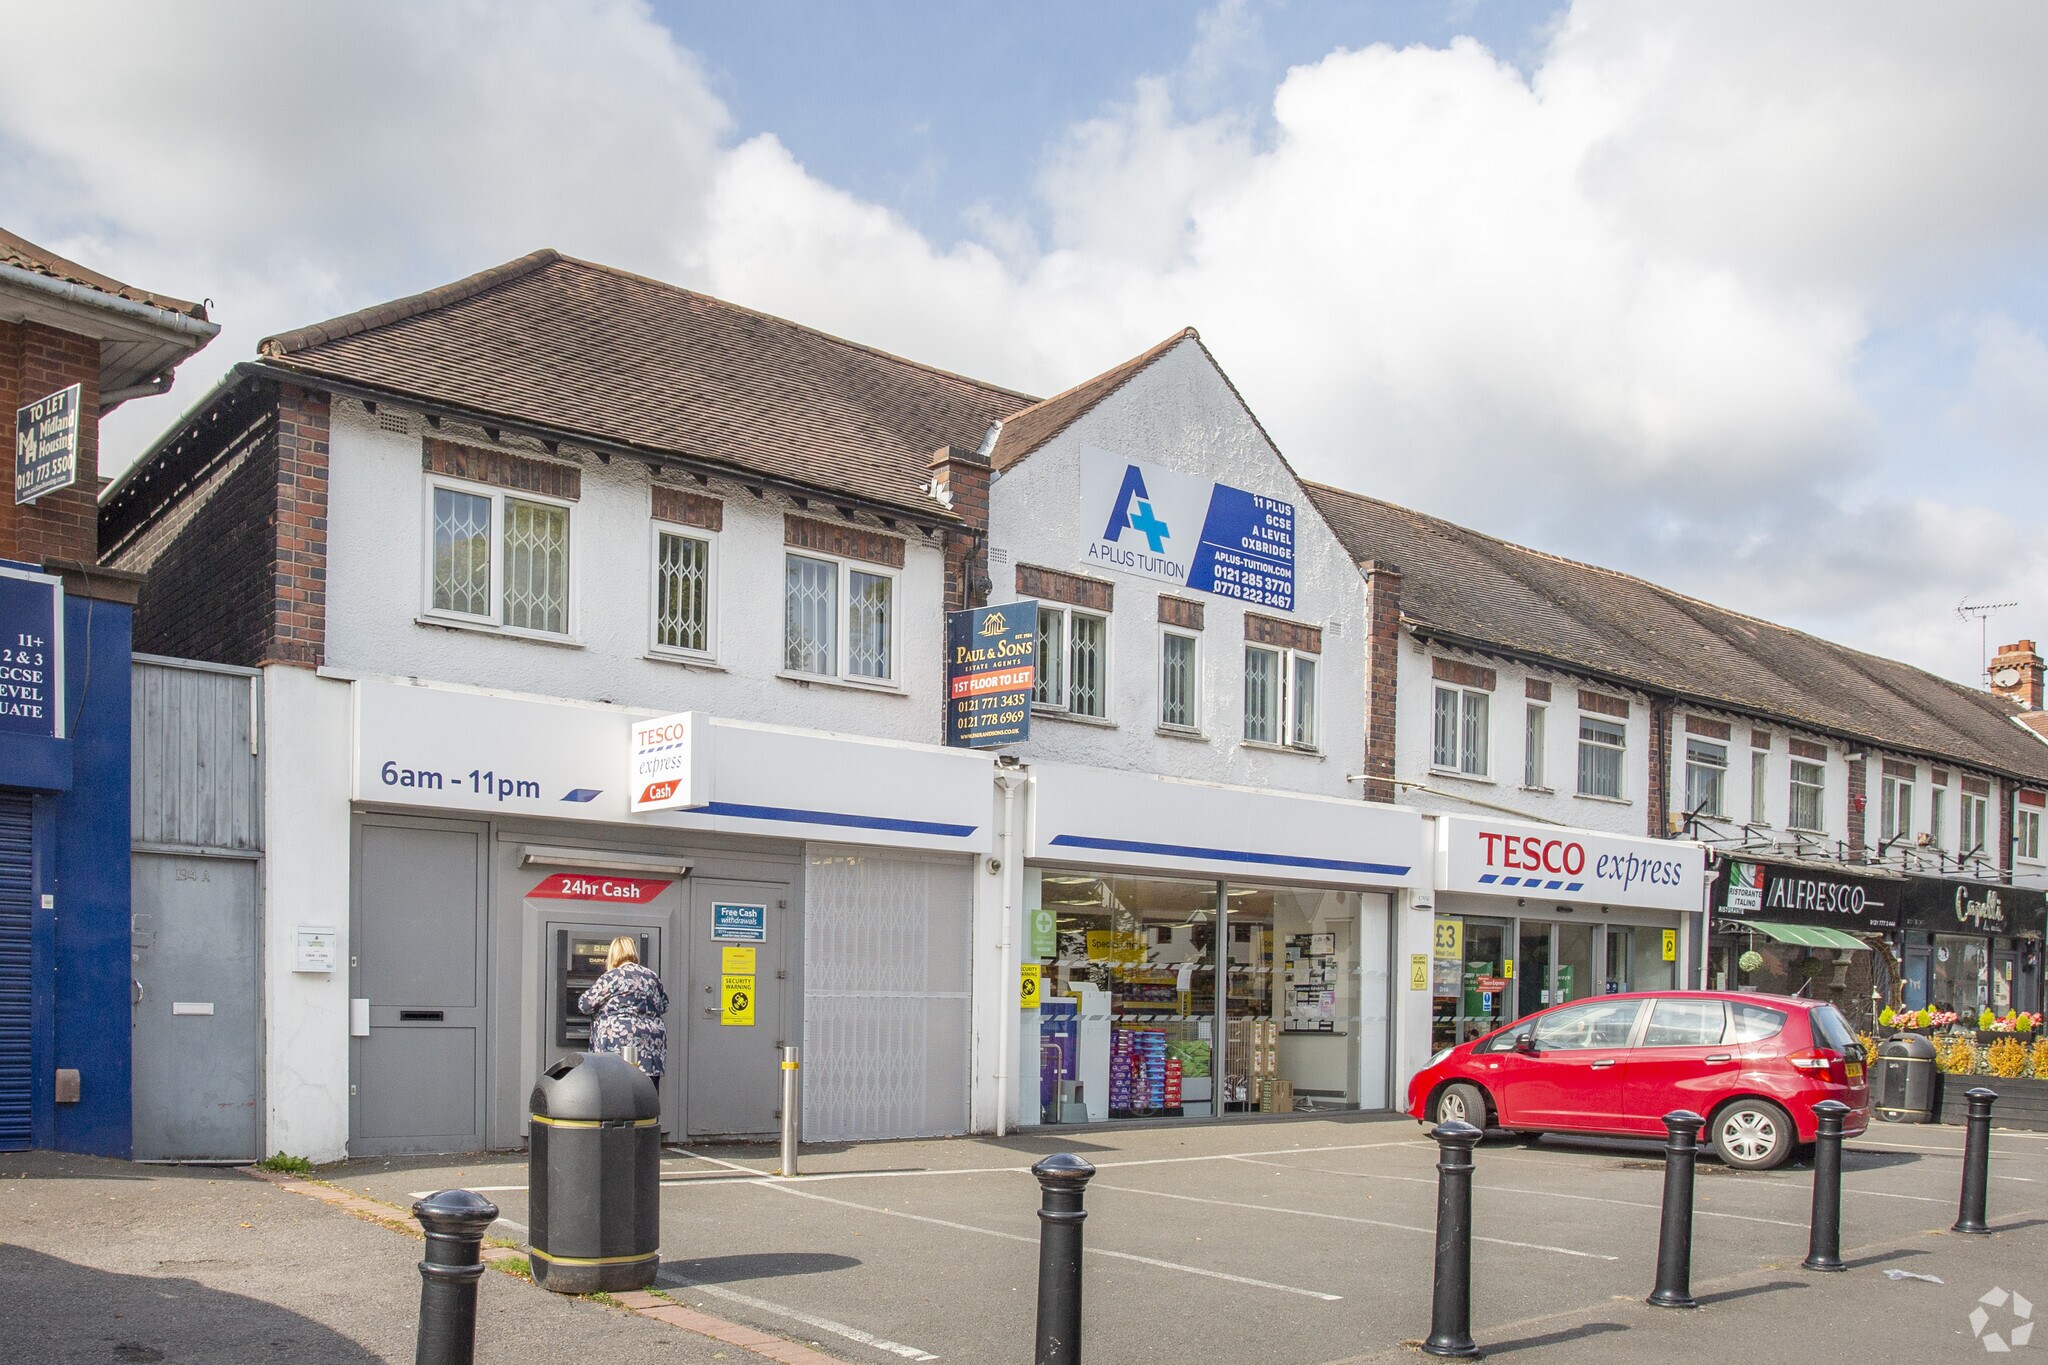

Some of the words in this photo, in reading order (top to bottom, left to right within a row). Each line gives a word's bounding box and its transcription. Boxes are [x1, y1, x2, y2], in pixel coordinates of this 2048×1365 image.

[30, 404, 43, 423] TO
[46, 393, 65, 416] LET
[40, 409, 74, 439] Midland
[39, 433, 74, 458] Housing
[17, 471, 34, 490] 0121
[37, 462, 49, 482] 773
[52, 454, 73, 475] 5500
[1254, 497, 1263, 509] 11
[1266, 500, 1291, 516] PLUS
[1266, 514, 1291, 530] GCSE
[1252, 525, 1259, 536] A
[1262, 528, 1291, 545] LEVEL
[1242, 537, 1291, 559] OXBRIDGE
[1089, 543, 1098, 557] A
[1101, 545, 1134, 567] PLUS
[1137, 554, 1184, 579] TUITION
[1214, 551, 1291, 579] APLUS-TUITION.COM
[1214, 565, 1239, 582] 0121
[1242, 571, 1263, 587] 285
[1265, 576, 1291, 595] 3770
[1214, 580, 1240, 597] 0778
[1243, 586, 1262, 602] 222
[1265, 592, 1291, 609] 2467
[18, 634, 44, 647] 11+
[3, 650, 11, 662] 2
[16, 651, 30, 664] &
[34, 654, 43, 666] 3
[956, 646, 985, 664] PAUL
[987, 649, 996, 659] &
[998, 640, 1033, 658] SONS
[0, 666, 43, 683] GCSE
[965, 664, 988, 672] ESTATE
[993, 659, 1021, 668] AGENTS
[954, 681, 969, 693] 1ST
[970, 677, 998, 691] FLOOR
[999, 675, 1011, 686] TO
[1013, 672, 1030, 684] LET
[958, 700, 978, 713] 0121
[982, 698, 998, 709] 771
[1001, 694, 1025, 707] 3435
[958, 716, 978, 729] 0121
[981, 714, 998, 726] 778
[1000, 710, 1024, 724] 6969
[638, 723, 684, 747] TESCO
[639, 753, 682, 778] express
[381, 760, 443, 789] 6am
[469, 769, 540, 801] 11pm
[649, 784, 671, 800] Cash
[1479, 832, 1585, 875] TESCO
[1596, 852, 1682, 891] express
[176, 868, 197, 881] 194
[201, 870, 210, 882] A
[562, 879, 599, 896] 24hr
[602, 882, 640, 898] Cash
[1729, 888, 1762, 898] RISTORANTE
[1766, 878, 1865, 914] ALFRESCO
[721, 908, 738, 916] Free
[739, 908, 757, 917] Cash
[721, 916, 757, 925] withdrawals
[1436, 924, 1455, 948] £3
